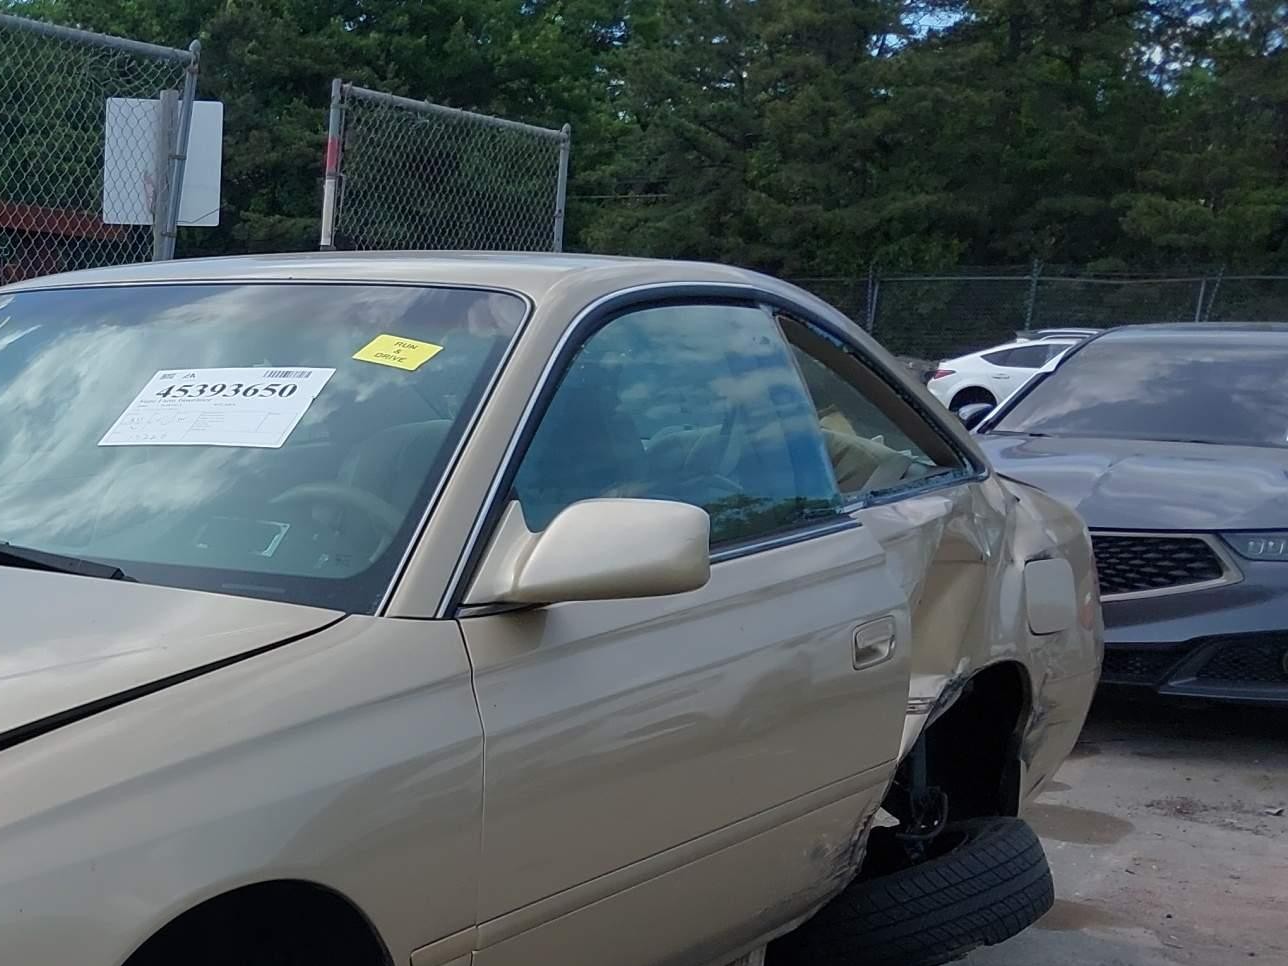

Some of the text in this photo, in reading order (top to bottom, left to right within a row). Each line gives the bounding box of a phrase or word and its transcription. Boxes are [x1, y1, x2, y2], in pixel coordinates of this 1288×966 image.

[394, 341, 418, 350] RUN
[374, 352, 407, 363] DRIVE
[155, 383, 298, 398] 45393650
